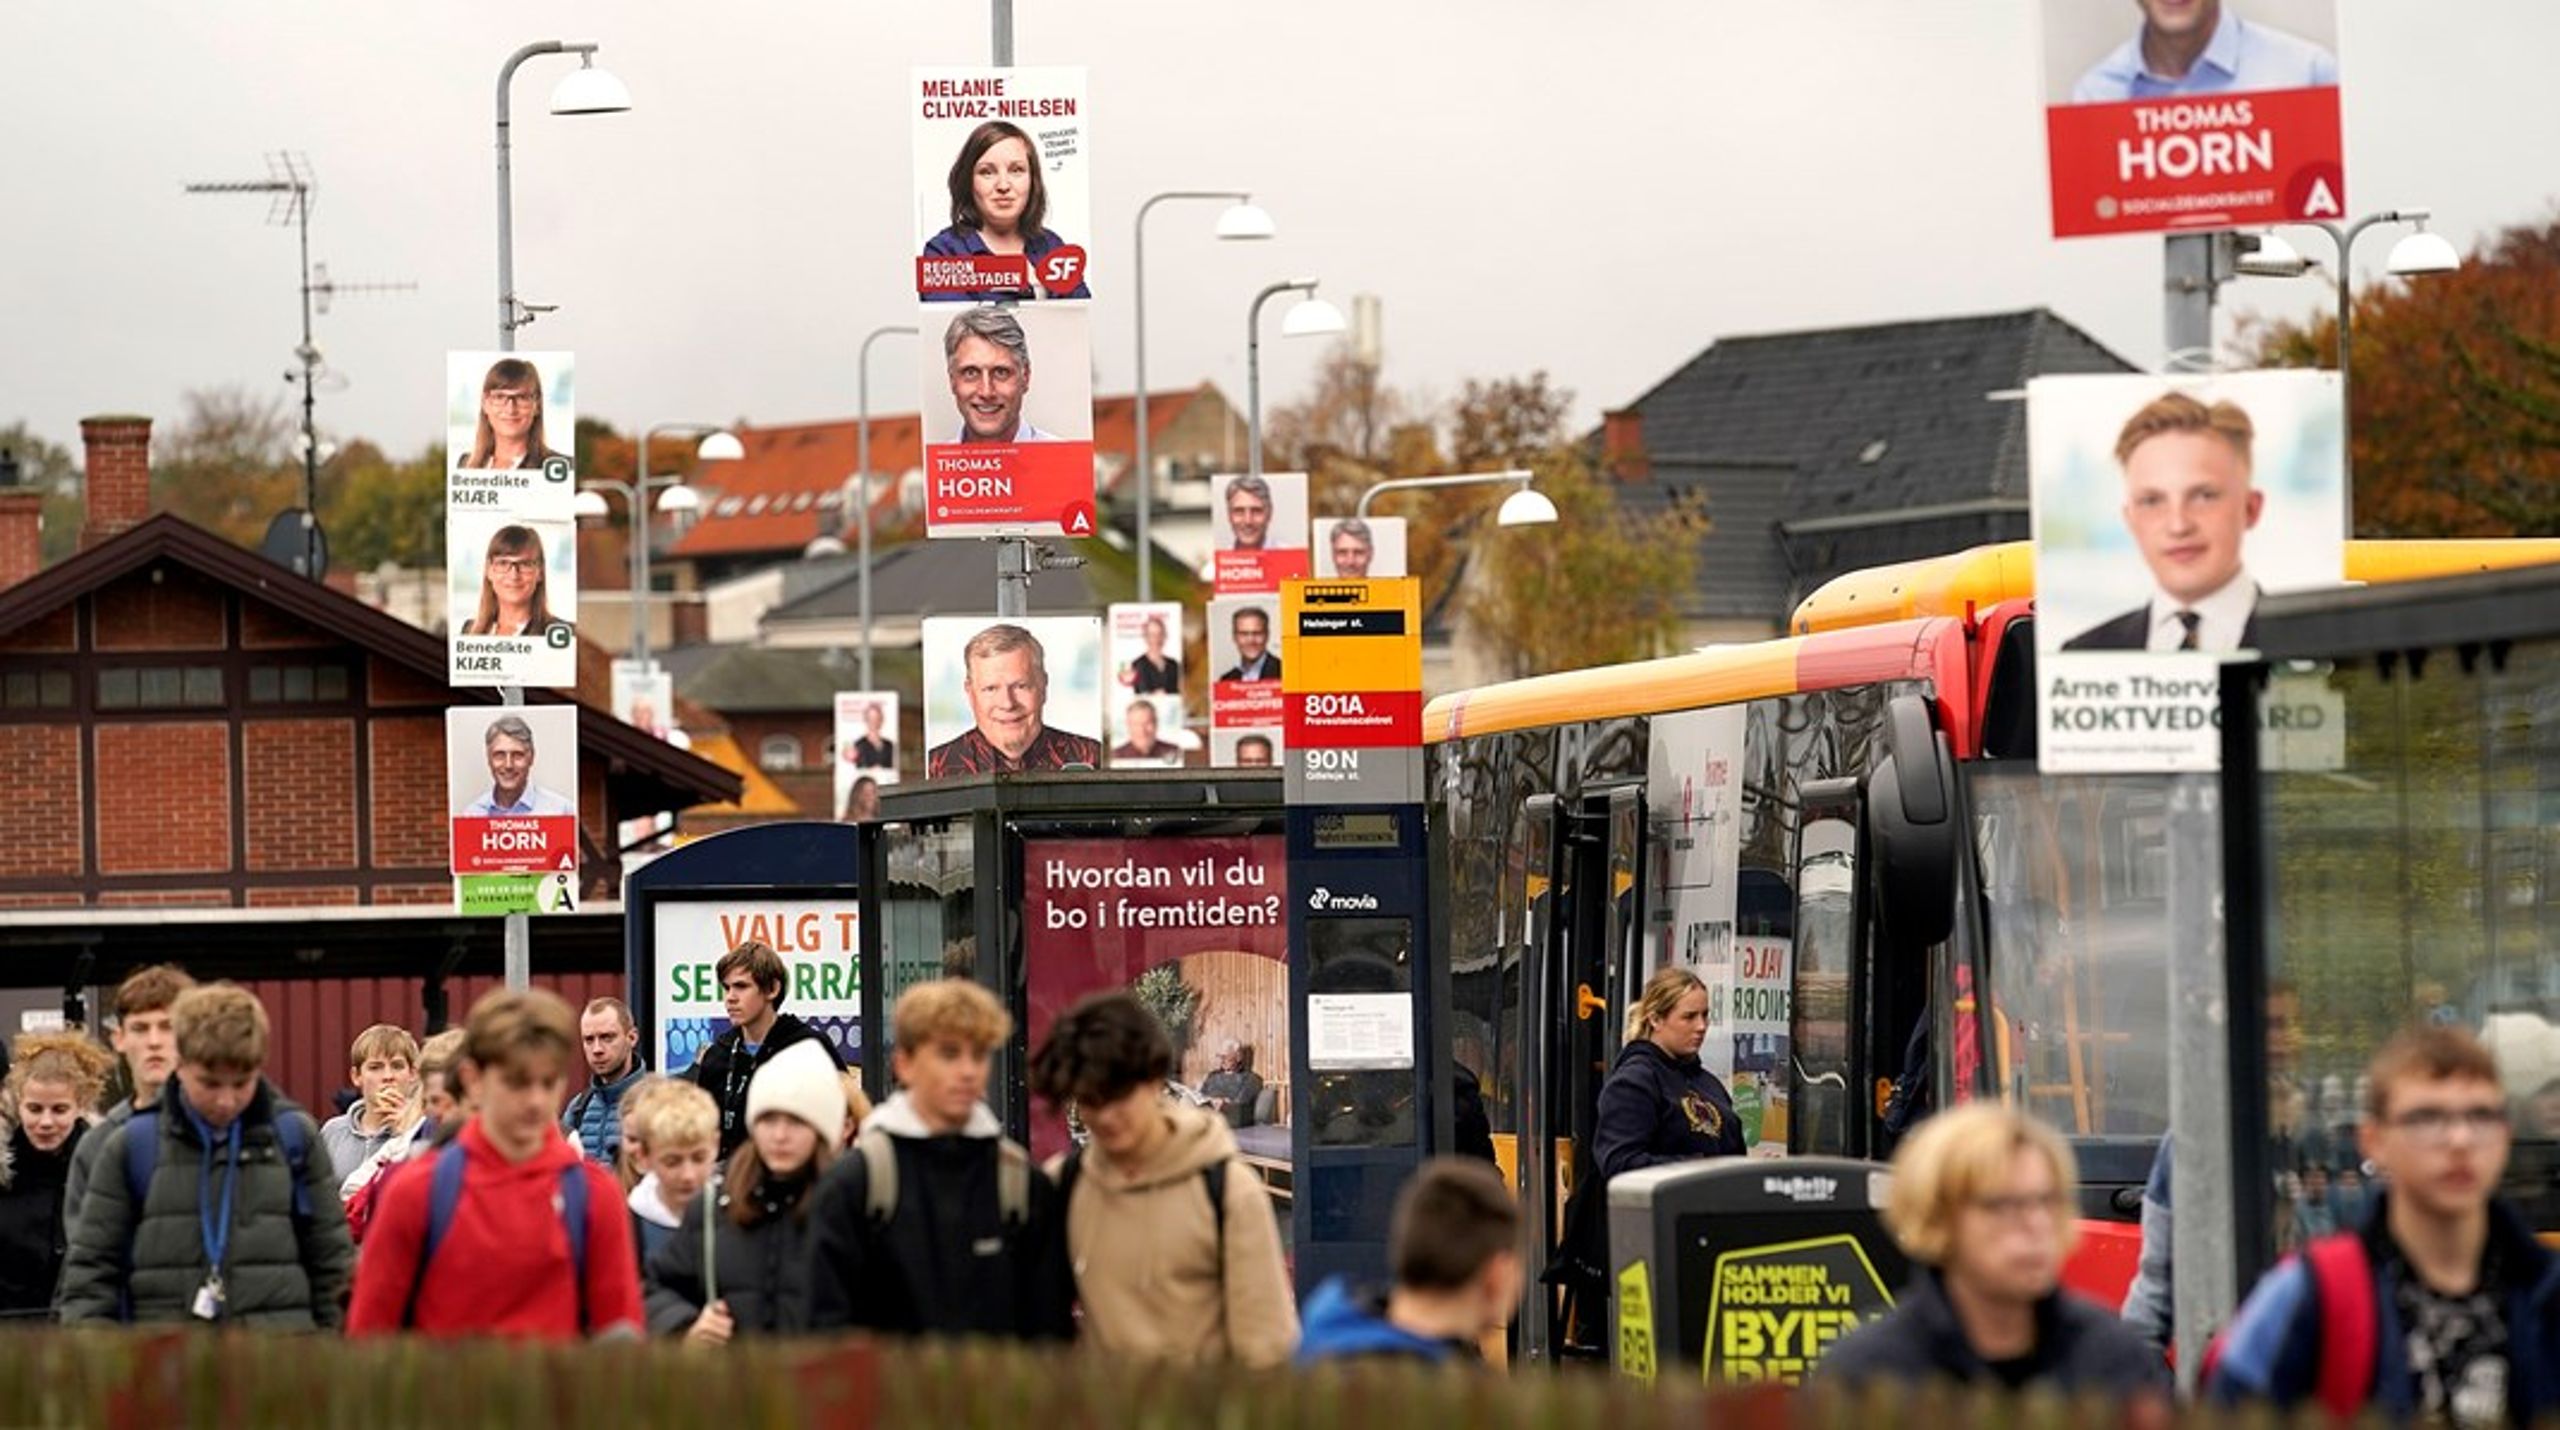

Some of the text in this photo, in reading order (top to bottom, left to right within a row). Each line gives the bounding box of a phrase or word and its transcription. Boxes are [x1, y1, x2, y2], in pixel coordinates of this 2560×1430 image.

[922, 79, 1004, 98] MELANIE
[922, 99, 1077, 118] CLIVAZ-NIELSEN
[2133, 100, 2254, 133] THOMAS
[2117, 129, 2274, 182] HORN
[2303, 176, 2339, 217] A
[922, 261, 975, 275] REGION
[1046, 257, 1079, 281] SF
[922, 273, 1021, 288] HOVEDSTADEN
[549, 463, 564, 480] C
[937, 458, 1002, 472] THOMAS
[452, 474, 529, 488] Benedikte
[938, 477, 1012, 498] HORN
[452, 489, 499, 504] KIÆR
[1071, 510, 1091, 531] A
[551, 628, 566, 646] C
[455, 641, 532, 654] Benedikte
[455, 656, 502, 671] KIÆR
[2052, 676, 2222, 697] Arne Thorv
[1305, 694, 1364, 716] 801A
[1306, 749, 1358, 769] 90 N
[489, 820, 539, 831] THOMAS
[482, 832, 547, 851] HORN
[558, 853, 574, 869] A
[1046, 856, 1265, 889] Hvordan vil du
[551, 874, 574, 911] Å
[1330, 893, 1378, 910] movia
[1046, 896, 1281, 929] bo i fremtiden?
[720, 913, 857, 952] VALG T
[671, 954, 861, 1003] SERRÅ
[1764, 1176, 1838, 1196] BigBelly
[1723, 1264, 1828, 1285] SAMMEN
[1723, 1284, 1850, 1305] HOLDER VI
